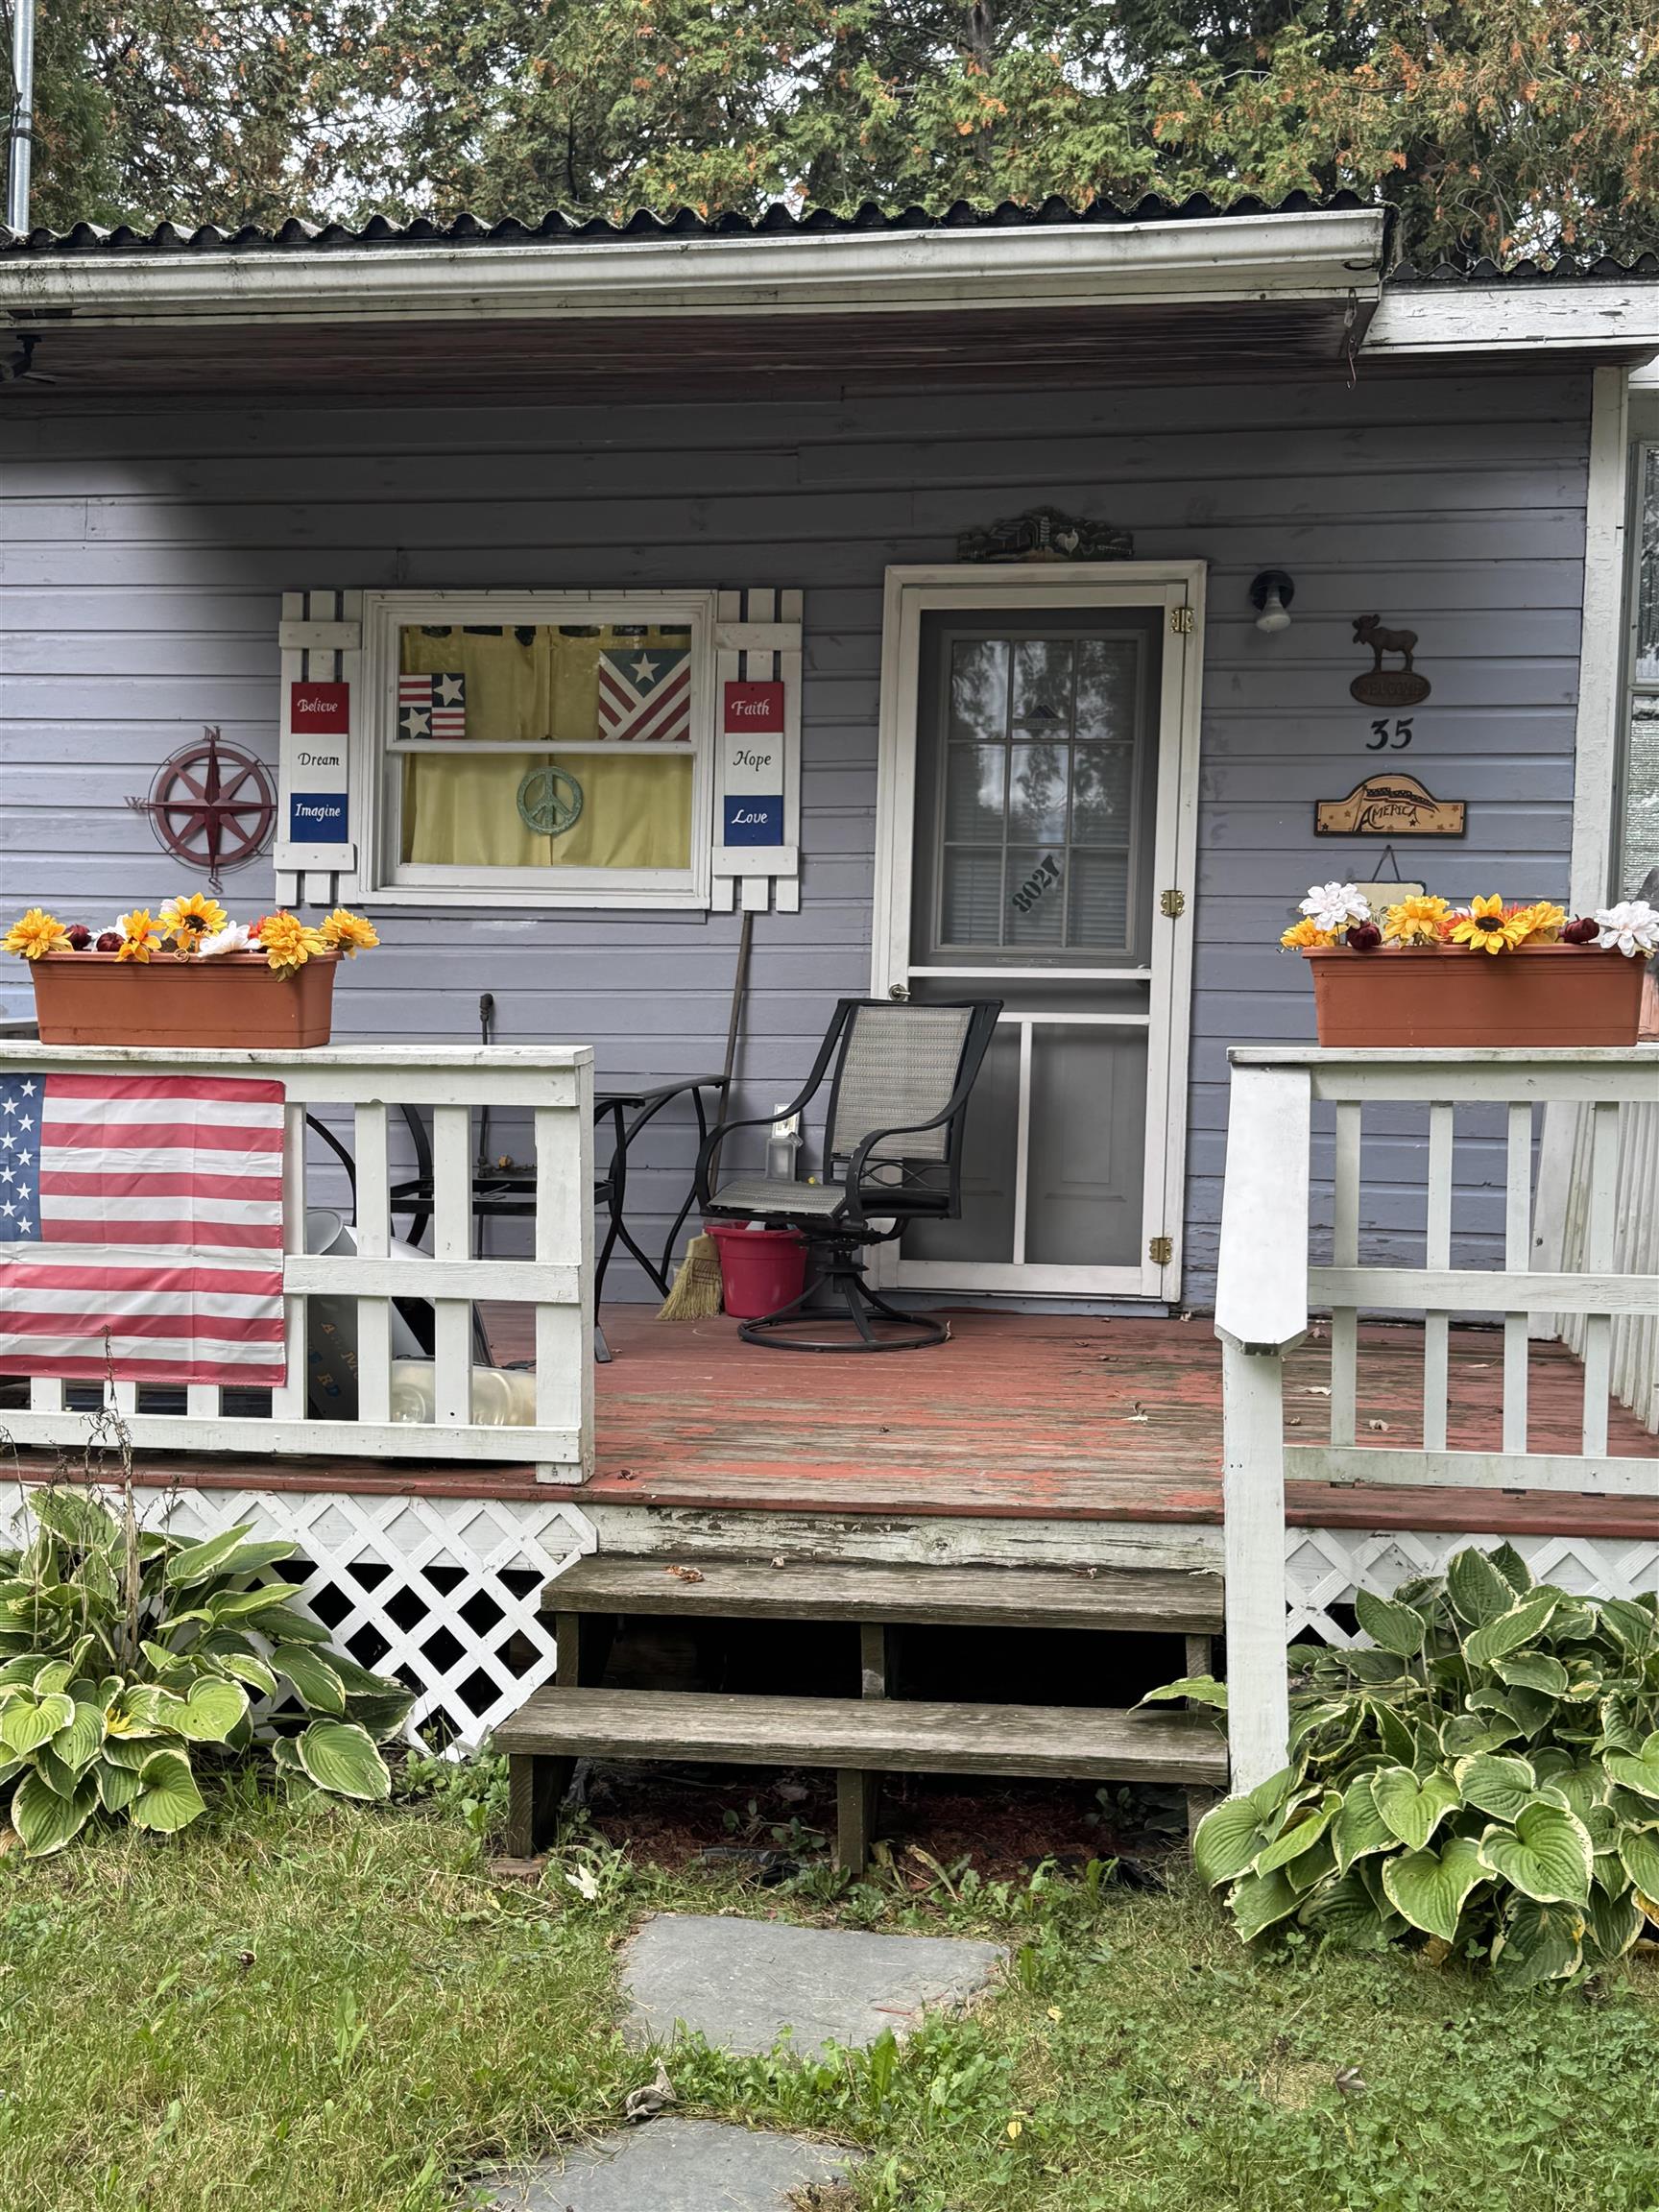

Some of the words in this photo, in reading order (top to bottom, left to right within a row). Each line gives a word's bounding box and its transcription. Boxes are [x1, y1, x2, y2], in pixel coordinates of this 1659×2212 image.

[297, 698, 338, 712] Believe
[731, 698, 770, 716] Faith
[203, 725, 223, 740] N
[1365, 717, 1414, 750] 35
[298, 752, 340, 766] Dream
[733, 750, 772, 772] Hope
[295, 803, 341, 822] Imagine
[731, 808, 768, 824] Love
[1355, 803, 1421, 833] AMERICA
[208, 877, 224, 895] S
[1012, 854, 1060, 913] 8027
